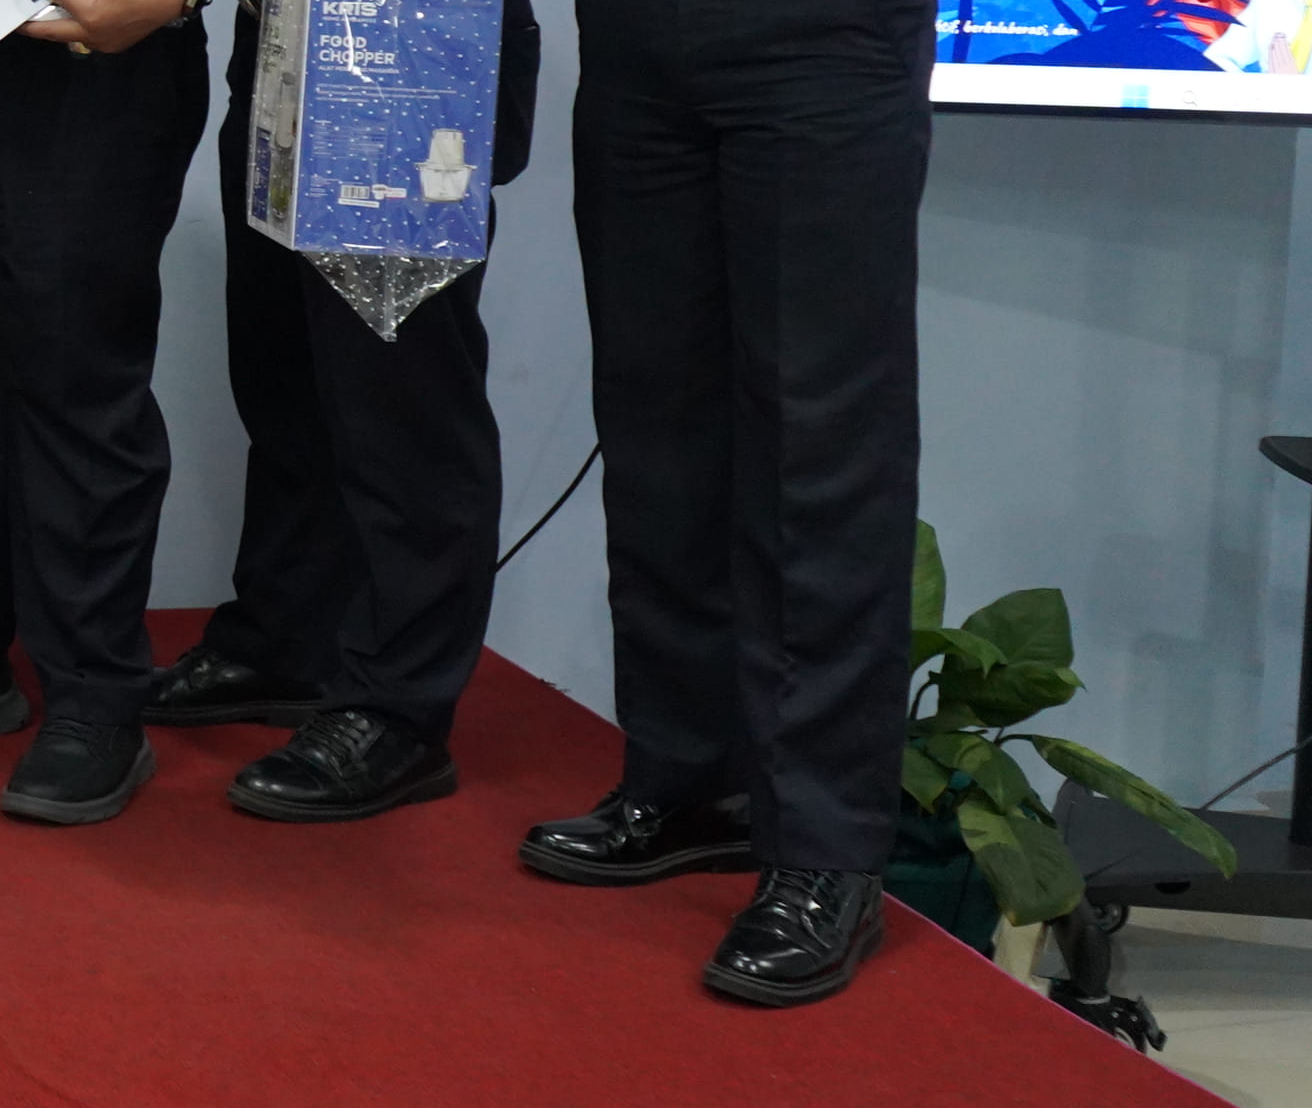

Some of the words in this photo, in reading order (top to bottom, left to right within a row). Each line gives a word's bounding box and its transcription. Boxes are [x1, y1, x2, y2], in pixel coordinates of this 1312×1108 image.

[322, 1, 378, 17] KRIS
[319, 35, 367, 49] FOOD
[319, 49, 395, 65] CHOPPER
